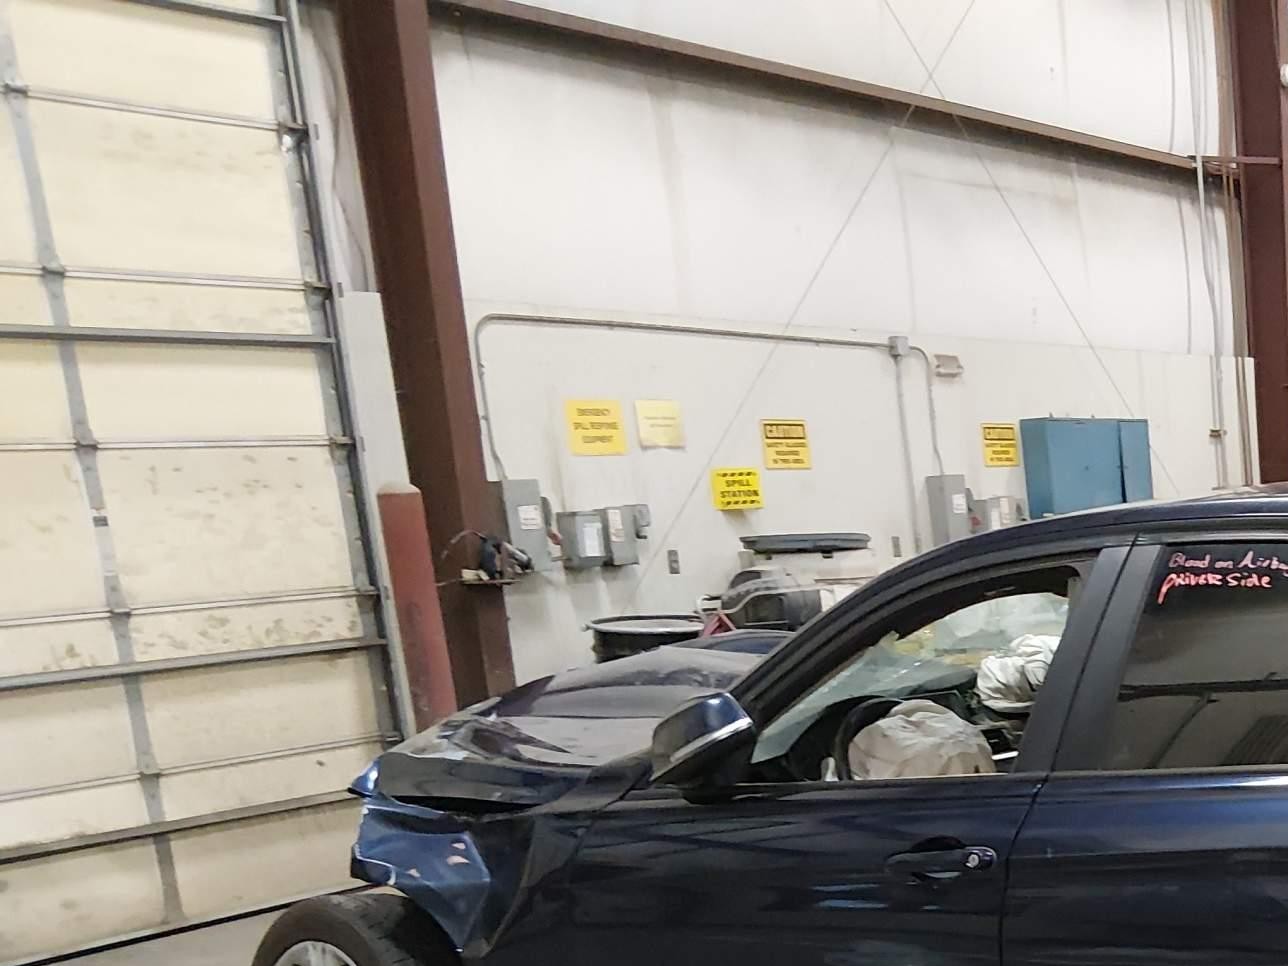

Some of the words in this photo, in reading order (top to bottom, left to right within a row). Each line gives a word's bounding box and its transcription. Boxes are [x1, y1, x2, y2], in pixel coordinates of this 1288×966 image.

[725, 479, 752, 487] SPILL
[720, 489, 759, 498] STATION
[1214, 560, 1234, 569] on
[1225, 572, 1272, 588] Side
